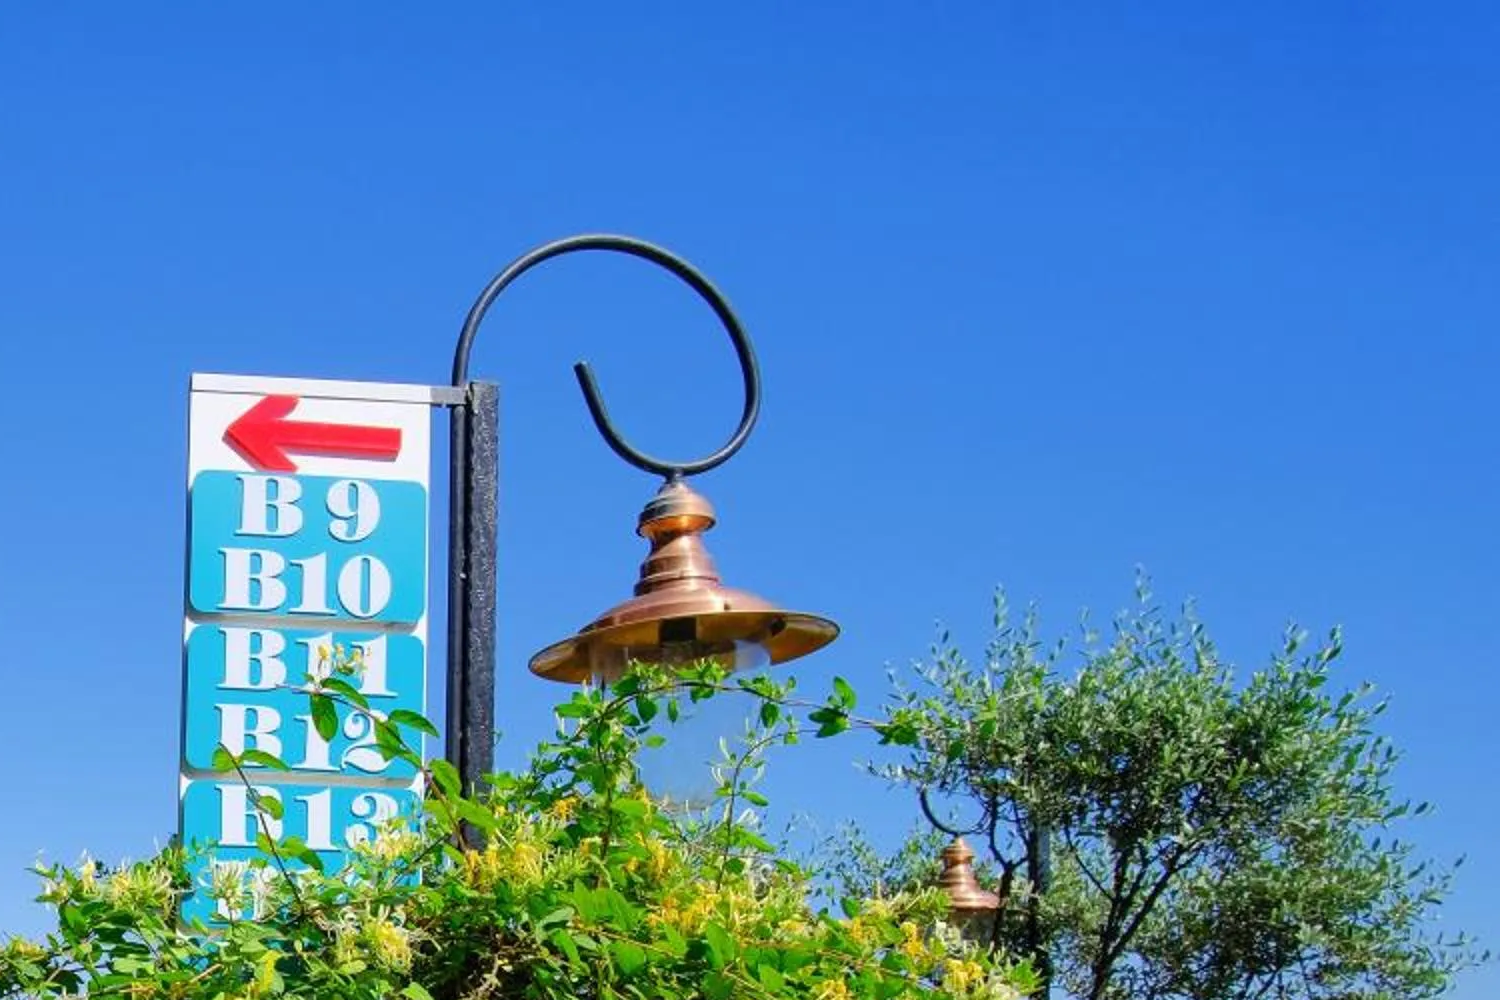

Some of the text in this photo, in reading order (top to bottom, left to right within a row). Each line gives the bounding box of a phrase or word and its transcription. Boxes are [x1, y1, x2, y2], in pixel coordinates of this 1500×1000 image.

[234, 473, 381, 542] B 9
[217, 547, 391, 619] B10
[216, 626, 398, 698] B11
[214, 703, 392, 773] B12
